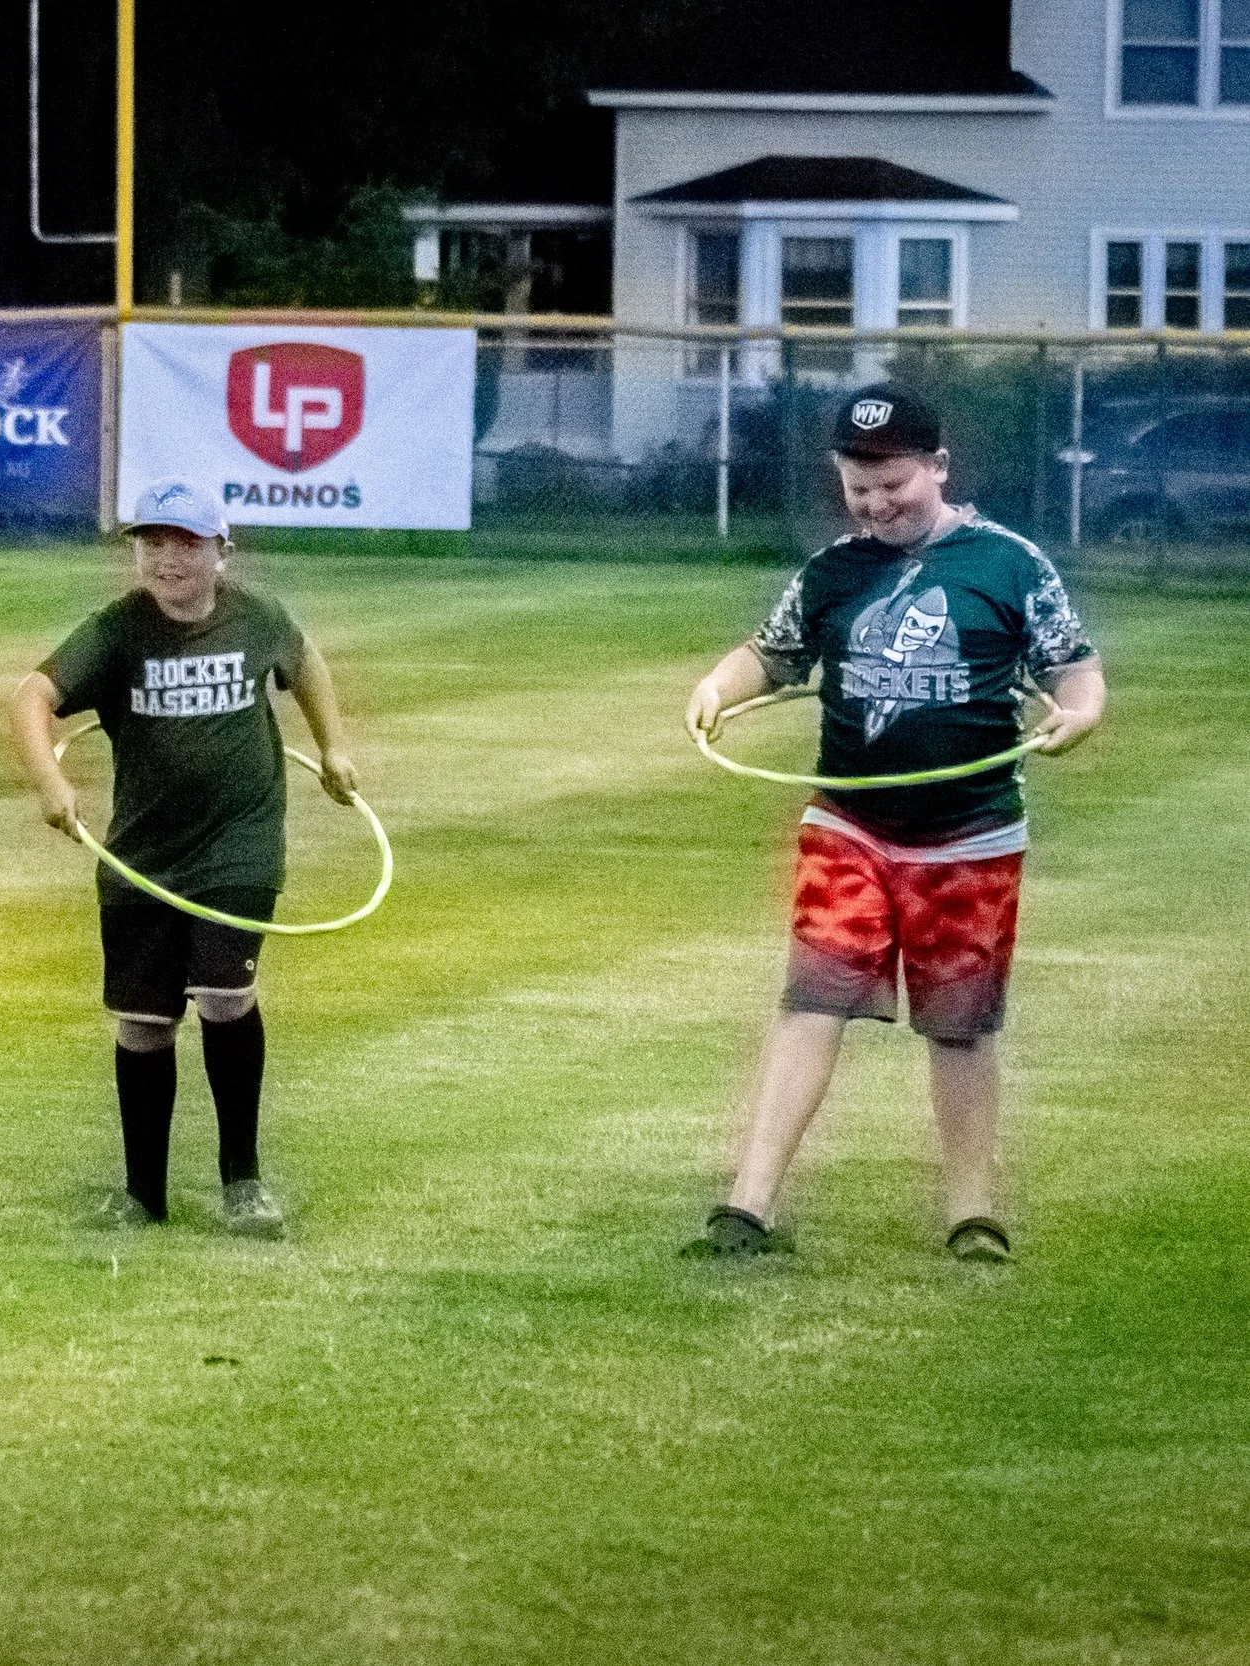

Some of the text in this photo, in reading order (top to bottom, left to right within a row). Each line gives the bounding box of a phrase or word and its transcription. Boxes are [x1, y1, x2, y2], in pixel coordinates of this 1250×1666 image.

[253, 361, 344, 452] LP
[854, 403, 888, 424] WM
[224, 482, 363, 509] PADNOS
[144, 652, 245, 689] ROCKET
[131, 679, 255, 717] BASEBALL
